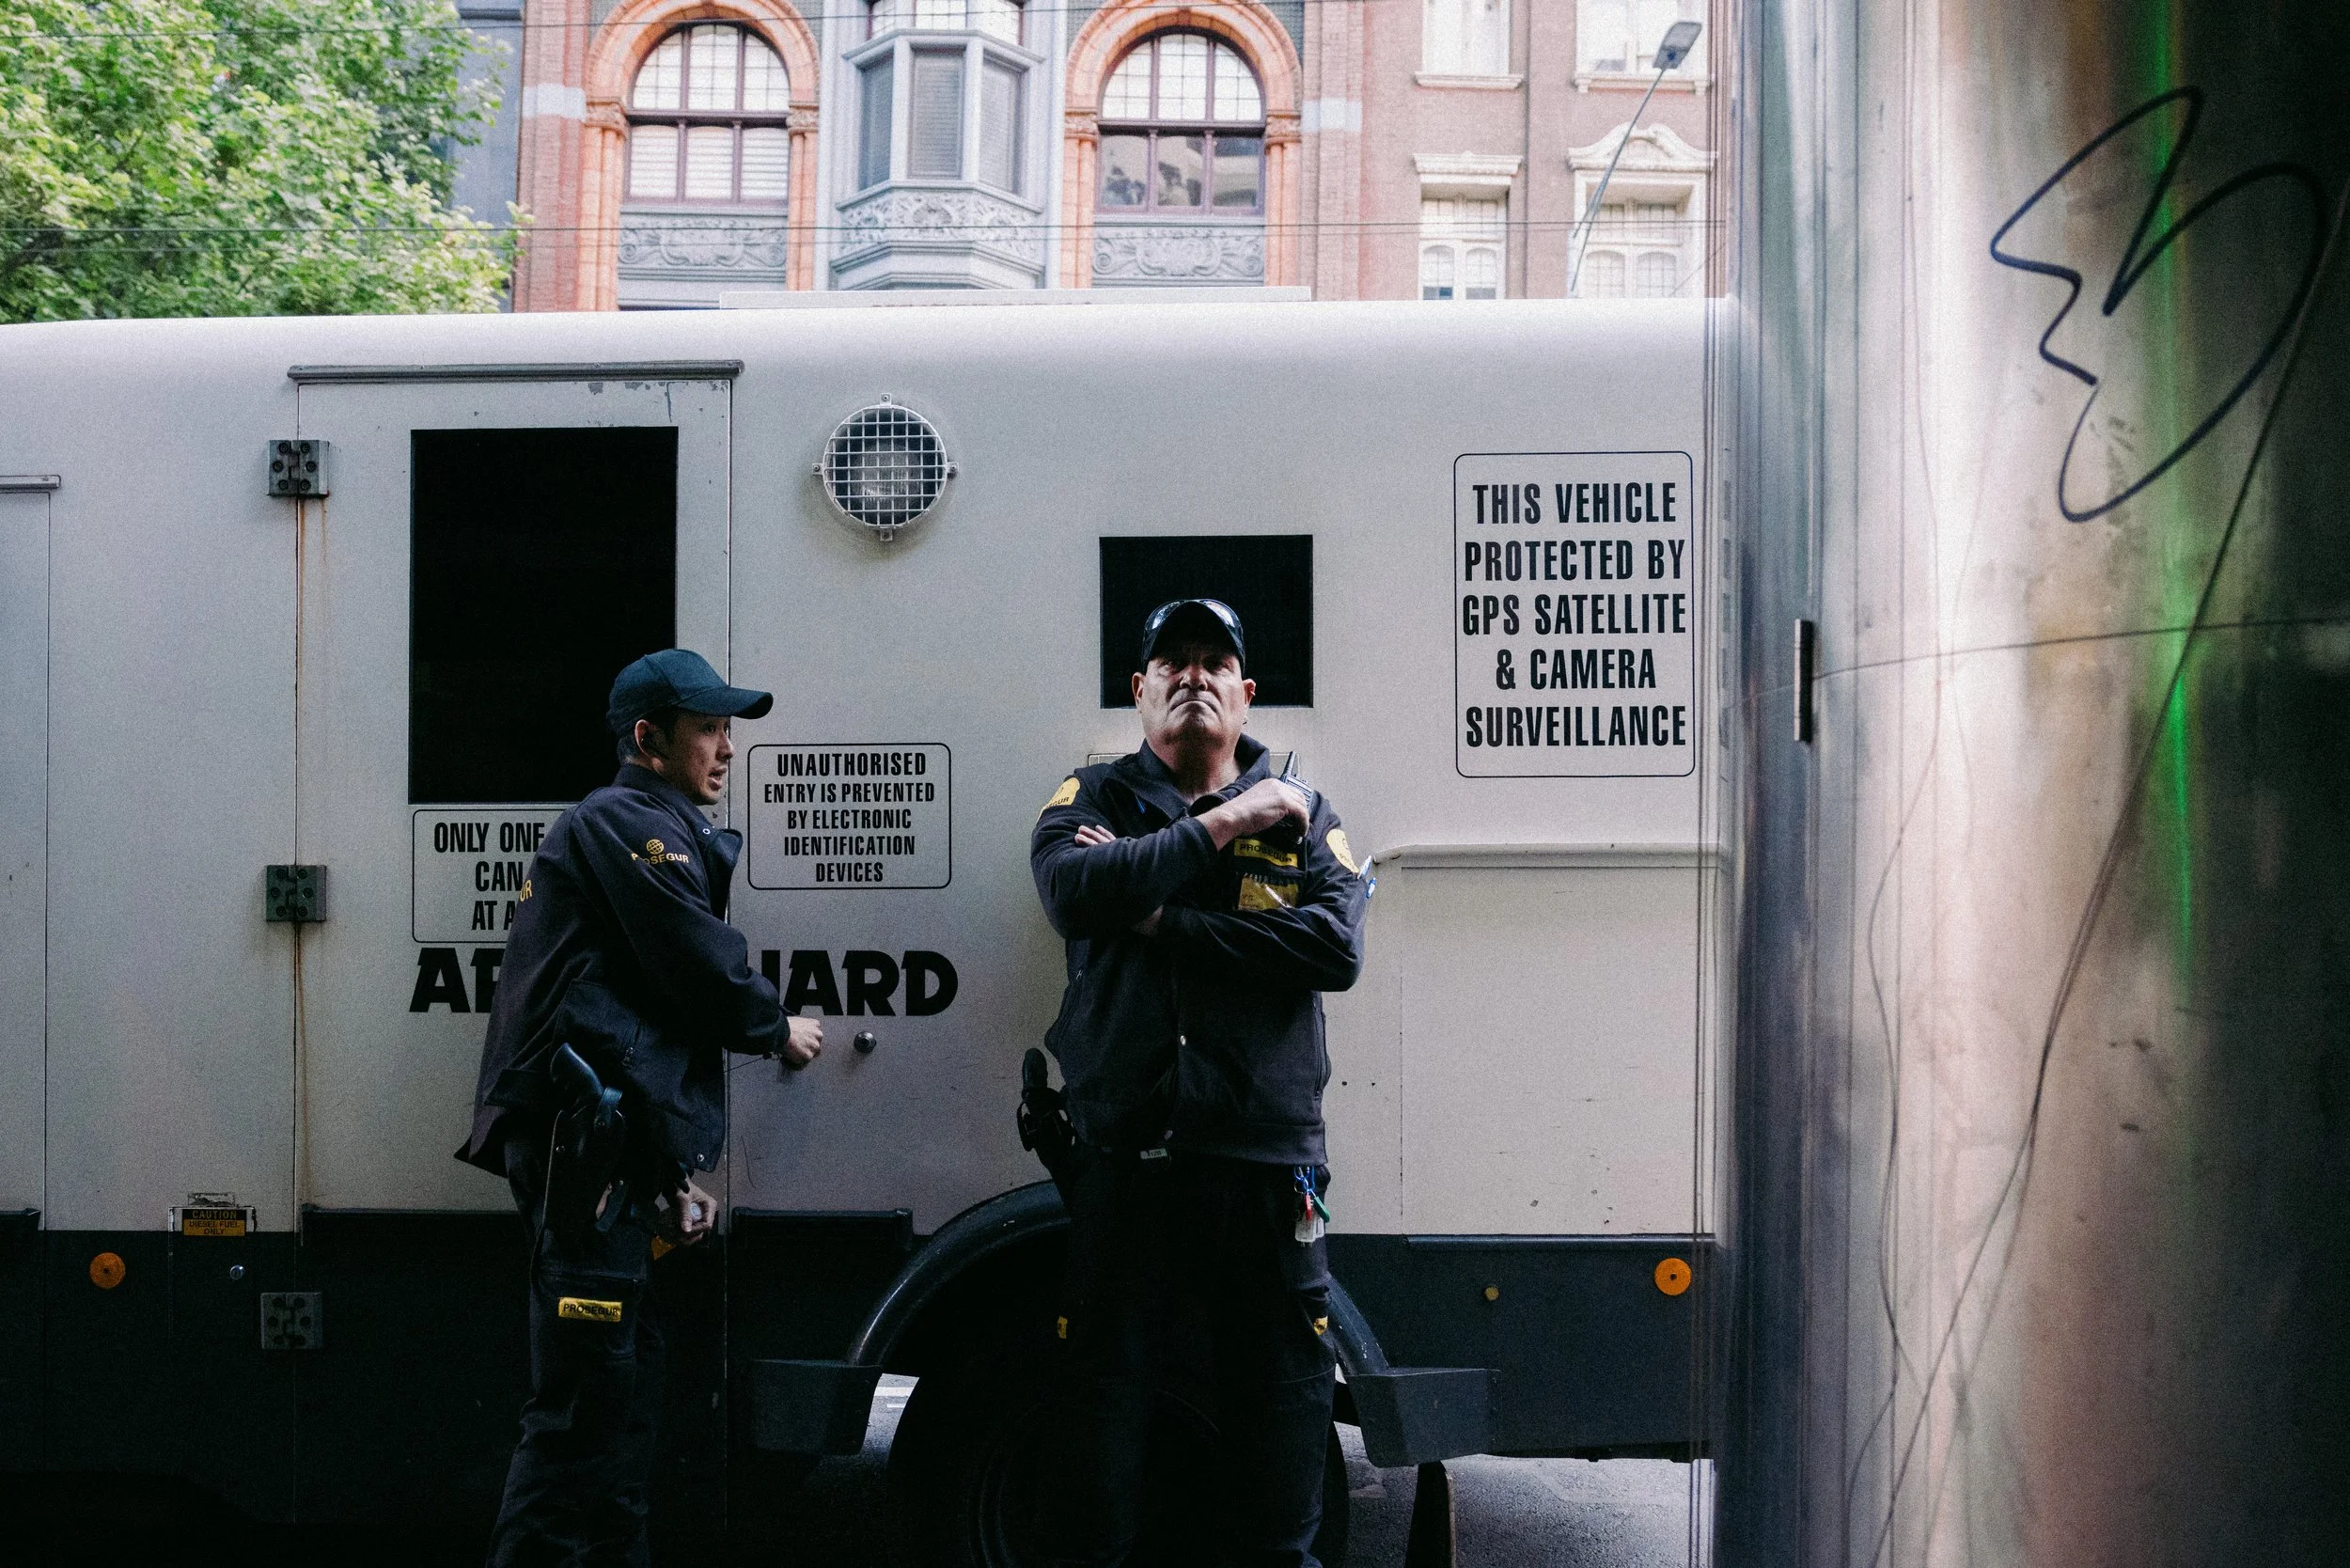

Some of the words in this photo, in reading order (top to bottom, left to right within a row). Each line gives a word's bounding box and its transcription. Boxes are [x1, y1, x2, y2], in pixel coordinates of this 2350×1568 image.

[1472, 483, 1541, 525] THIS
[1555, 481, 1676, 524] VEHICLE
[1465, 540, 1633, 582] PROTECTED
[1648, 540, 1685, 580] BY
[1463, 594, 1520, 635] GPS
[1534, 593, 1686, 635] SATELLITE
[1496, 649, 1516, 691] &
[1530, 649, 1656, 690] CAMERA
[1465, 705, 1686, 748] SURVEILLANCE
[777, 752, 927, 776] UNAUTHORISED
[764, 783, 816, 804] ENTRY
[821, 782, 837, 803] IS
[841, 782, 935, 803] PREVENTED
[787, 809, 807, 830] BY
[812, 808, 912, 830] ELECTRONIC
[433, 822, 490, 853] ONLY
[784, 835, 916, 856] IDENTIFICATION
[475, 860, 524, 892] CAN
[816, 861, 884, 883] DEVICES
[471, 900, 498, 931] AT
[192, 1210, 237, 1219] CAUTION
[563, 1303, 619, 1316] PROSEGUR
